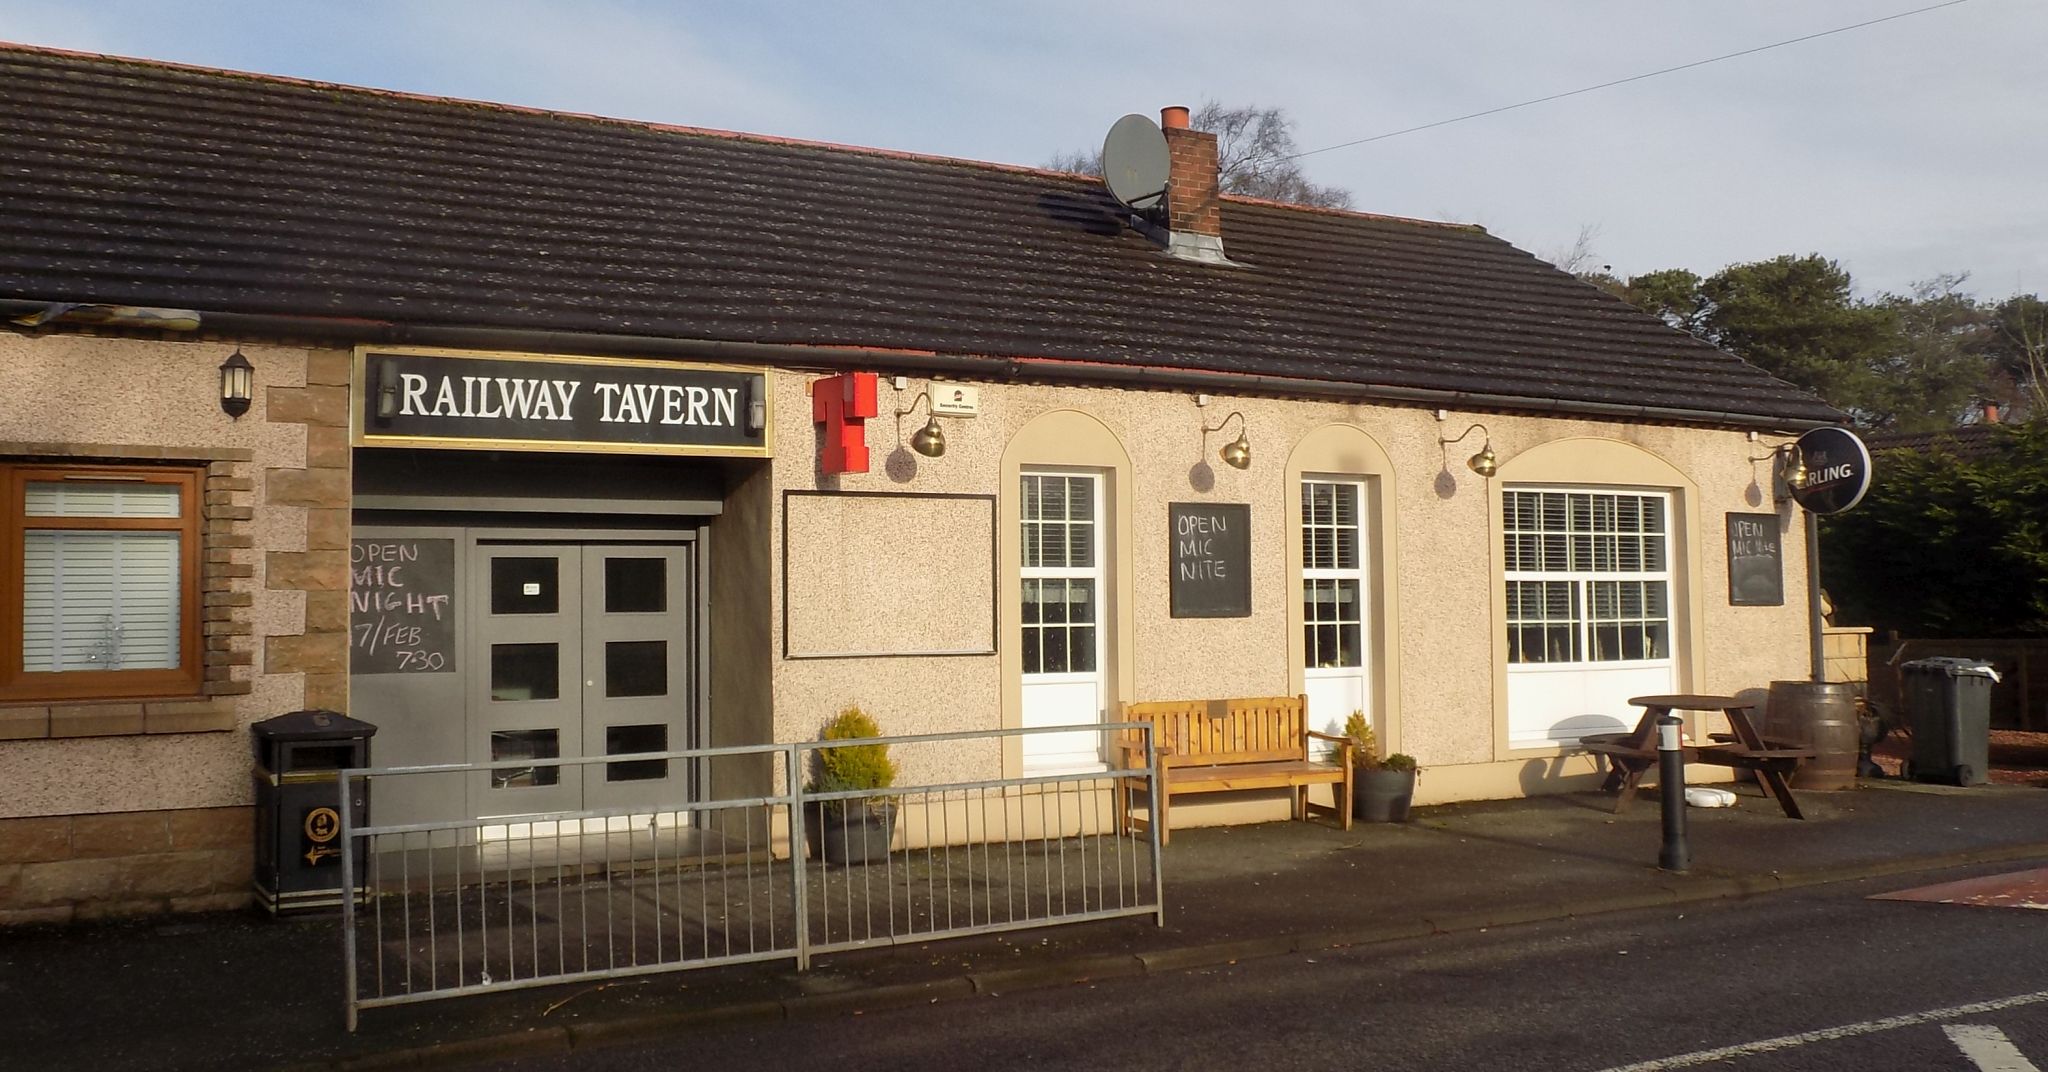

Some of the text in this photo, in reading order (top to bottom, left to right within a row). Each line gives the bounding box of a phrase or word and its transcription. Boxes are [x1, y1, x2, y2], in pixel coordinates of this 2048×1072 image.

[399, 373, 738, 427] RAILWAY TAVERN
[1804, 463, 1852, 487] RLING
[1178, 515, 1226, 535] OPEN
[351, 544, 418, 562] OPEN
[1180, 538, 1213, 558] MIC
[350, 565, 404, 588] MIC
[1180, 560, 1226, 581] NITE
[350, 591, 449, 620] NIGHT
